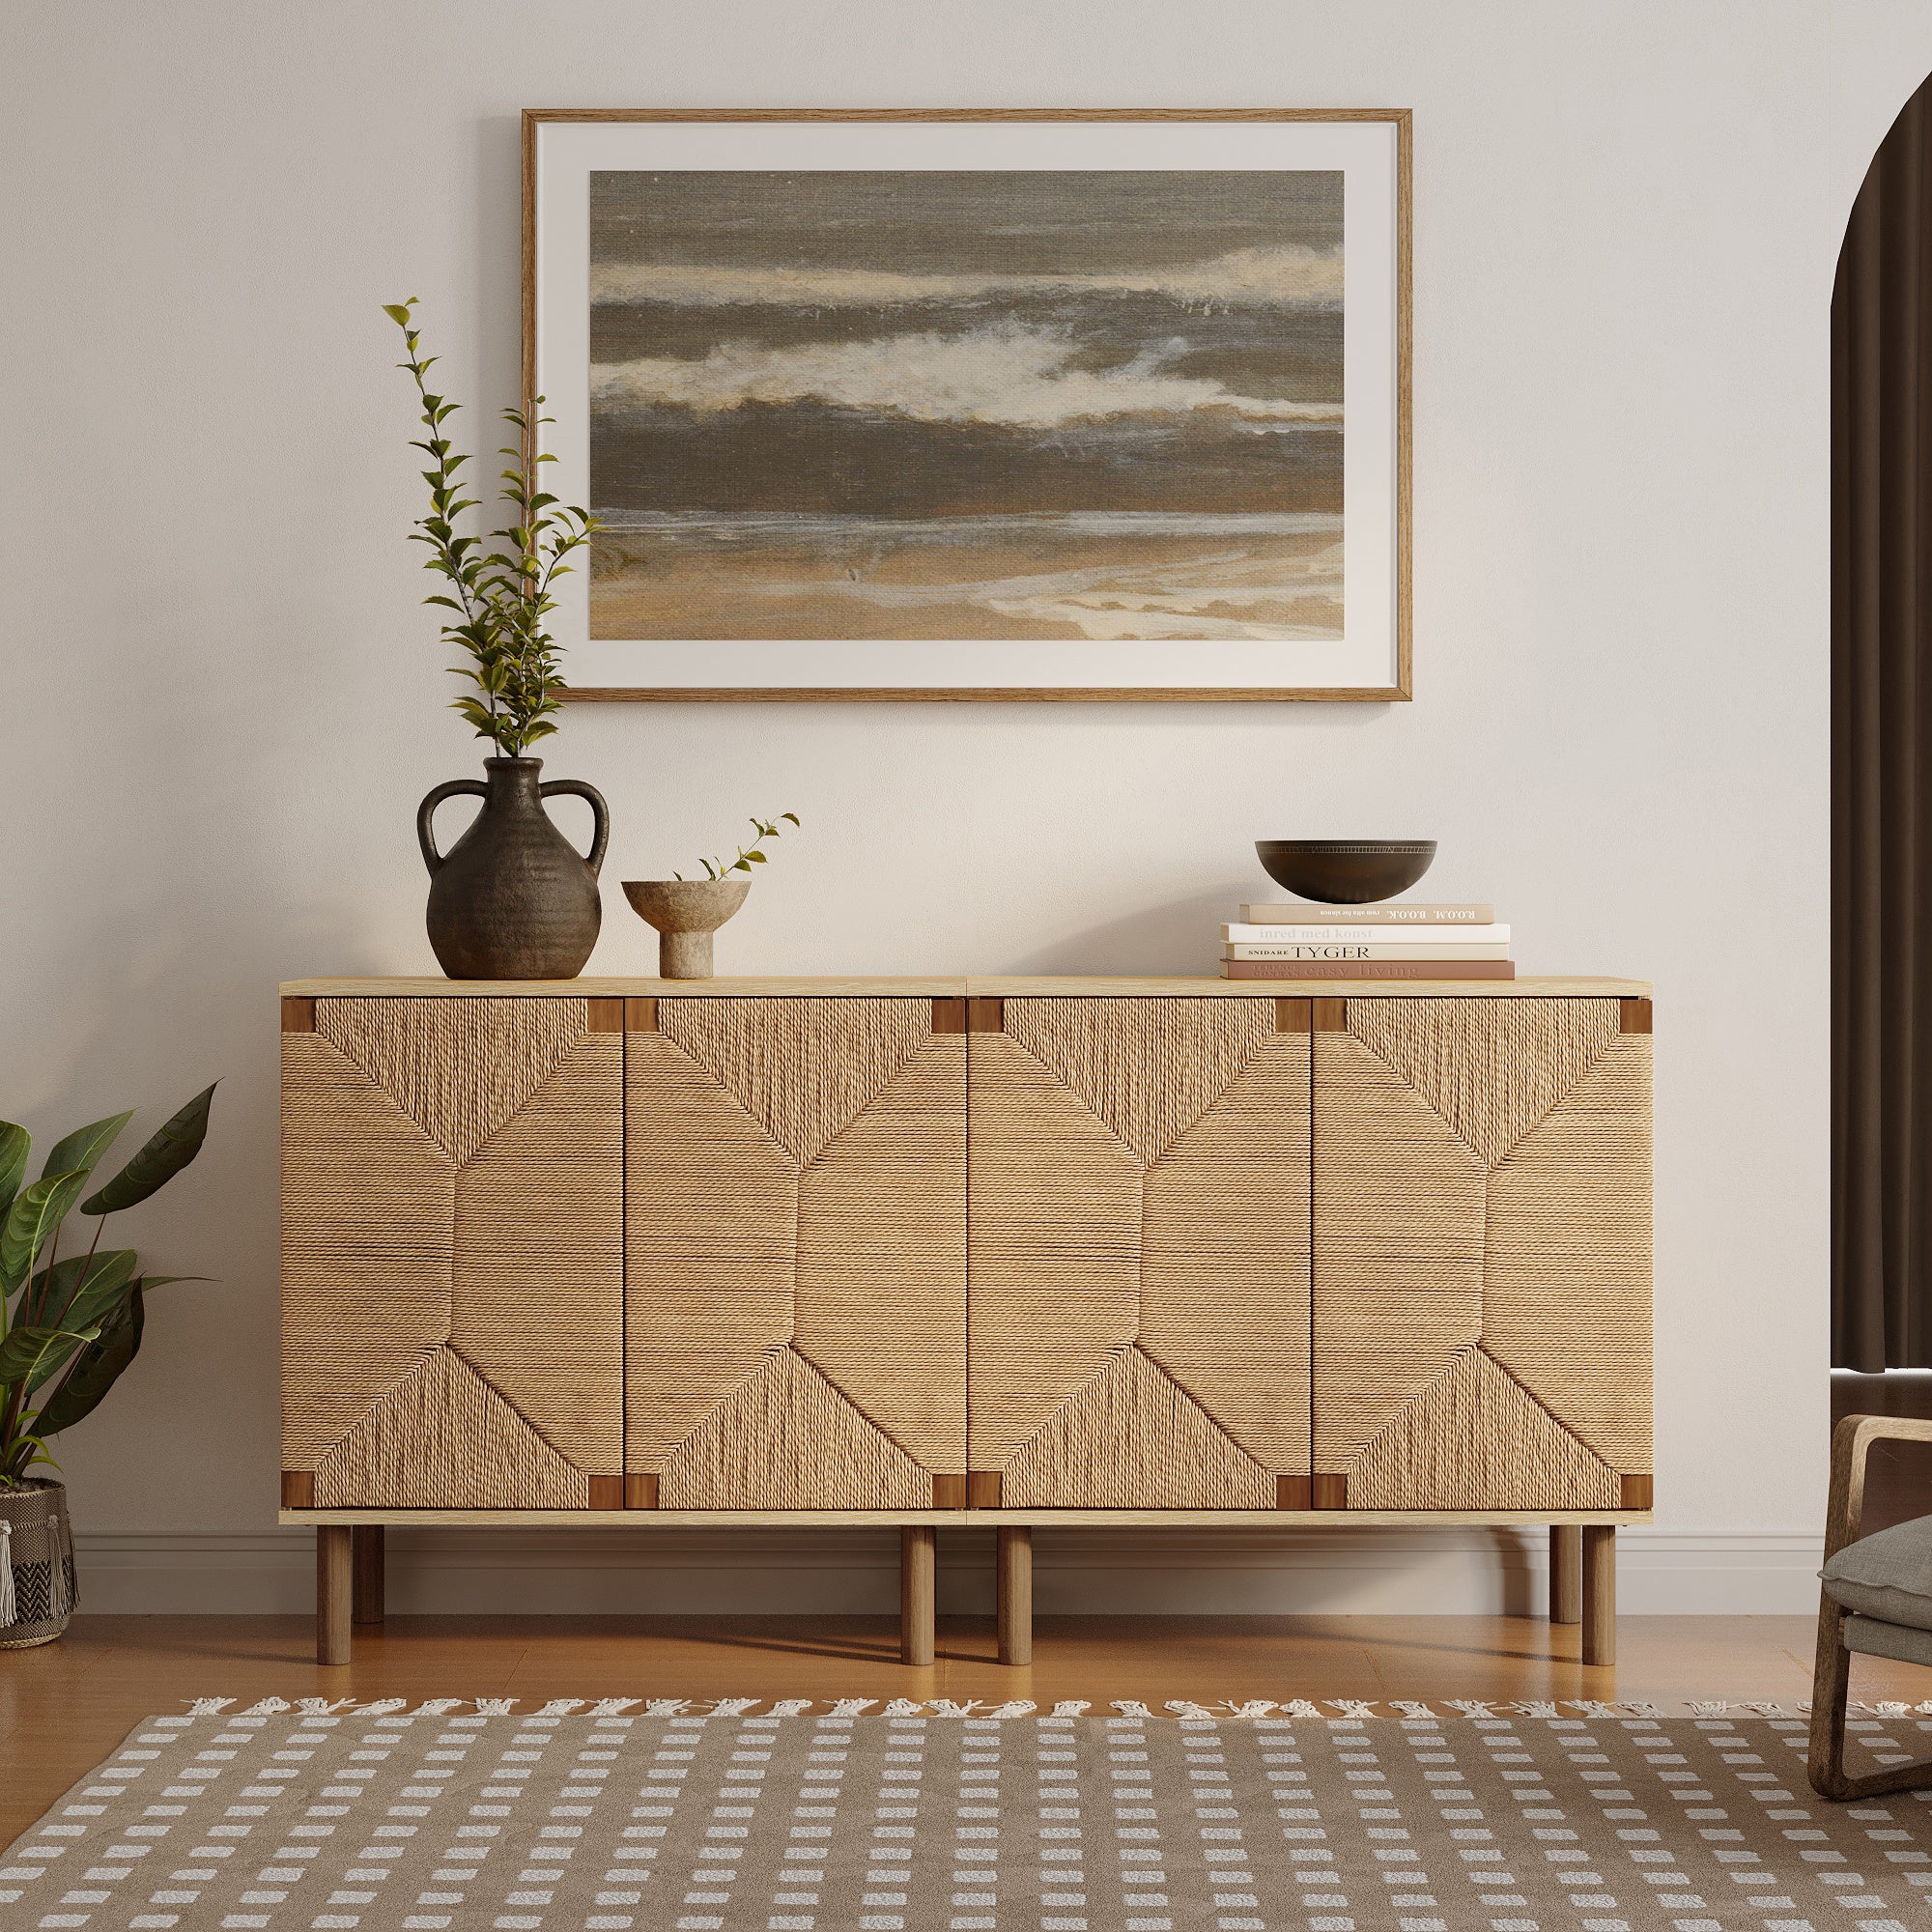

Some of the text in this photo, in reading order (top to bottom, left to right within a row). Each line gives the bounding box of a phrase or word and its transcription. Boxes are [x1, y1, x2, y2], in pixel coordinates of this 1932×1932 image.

[1260, 928, 1372, 939] inred med konst
[1292, 947, 1371, 958] TYGER
[1306, 964, 1419, 979] easy living
